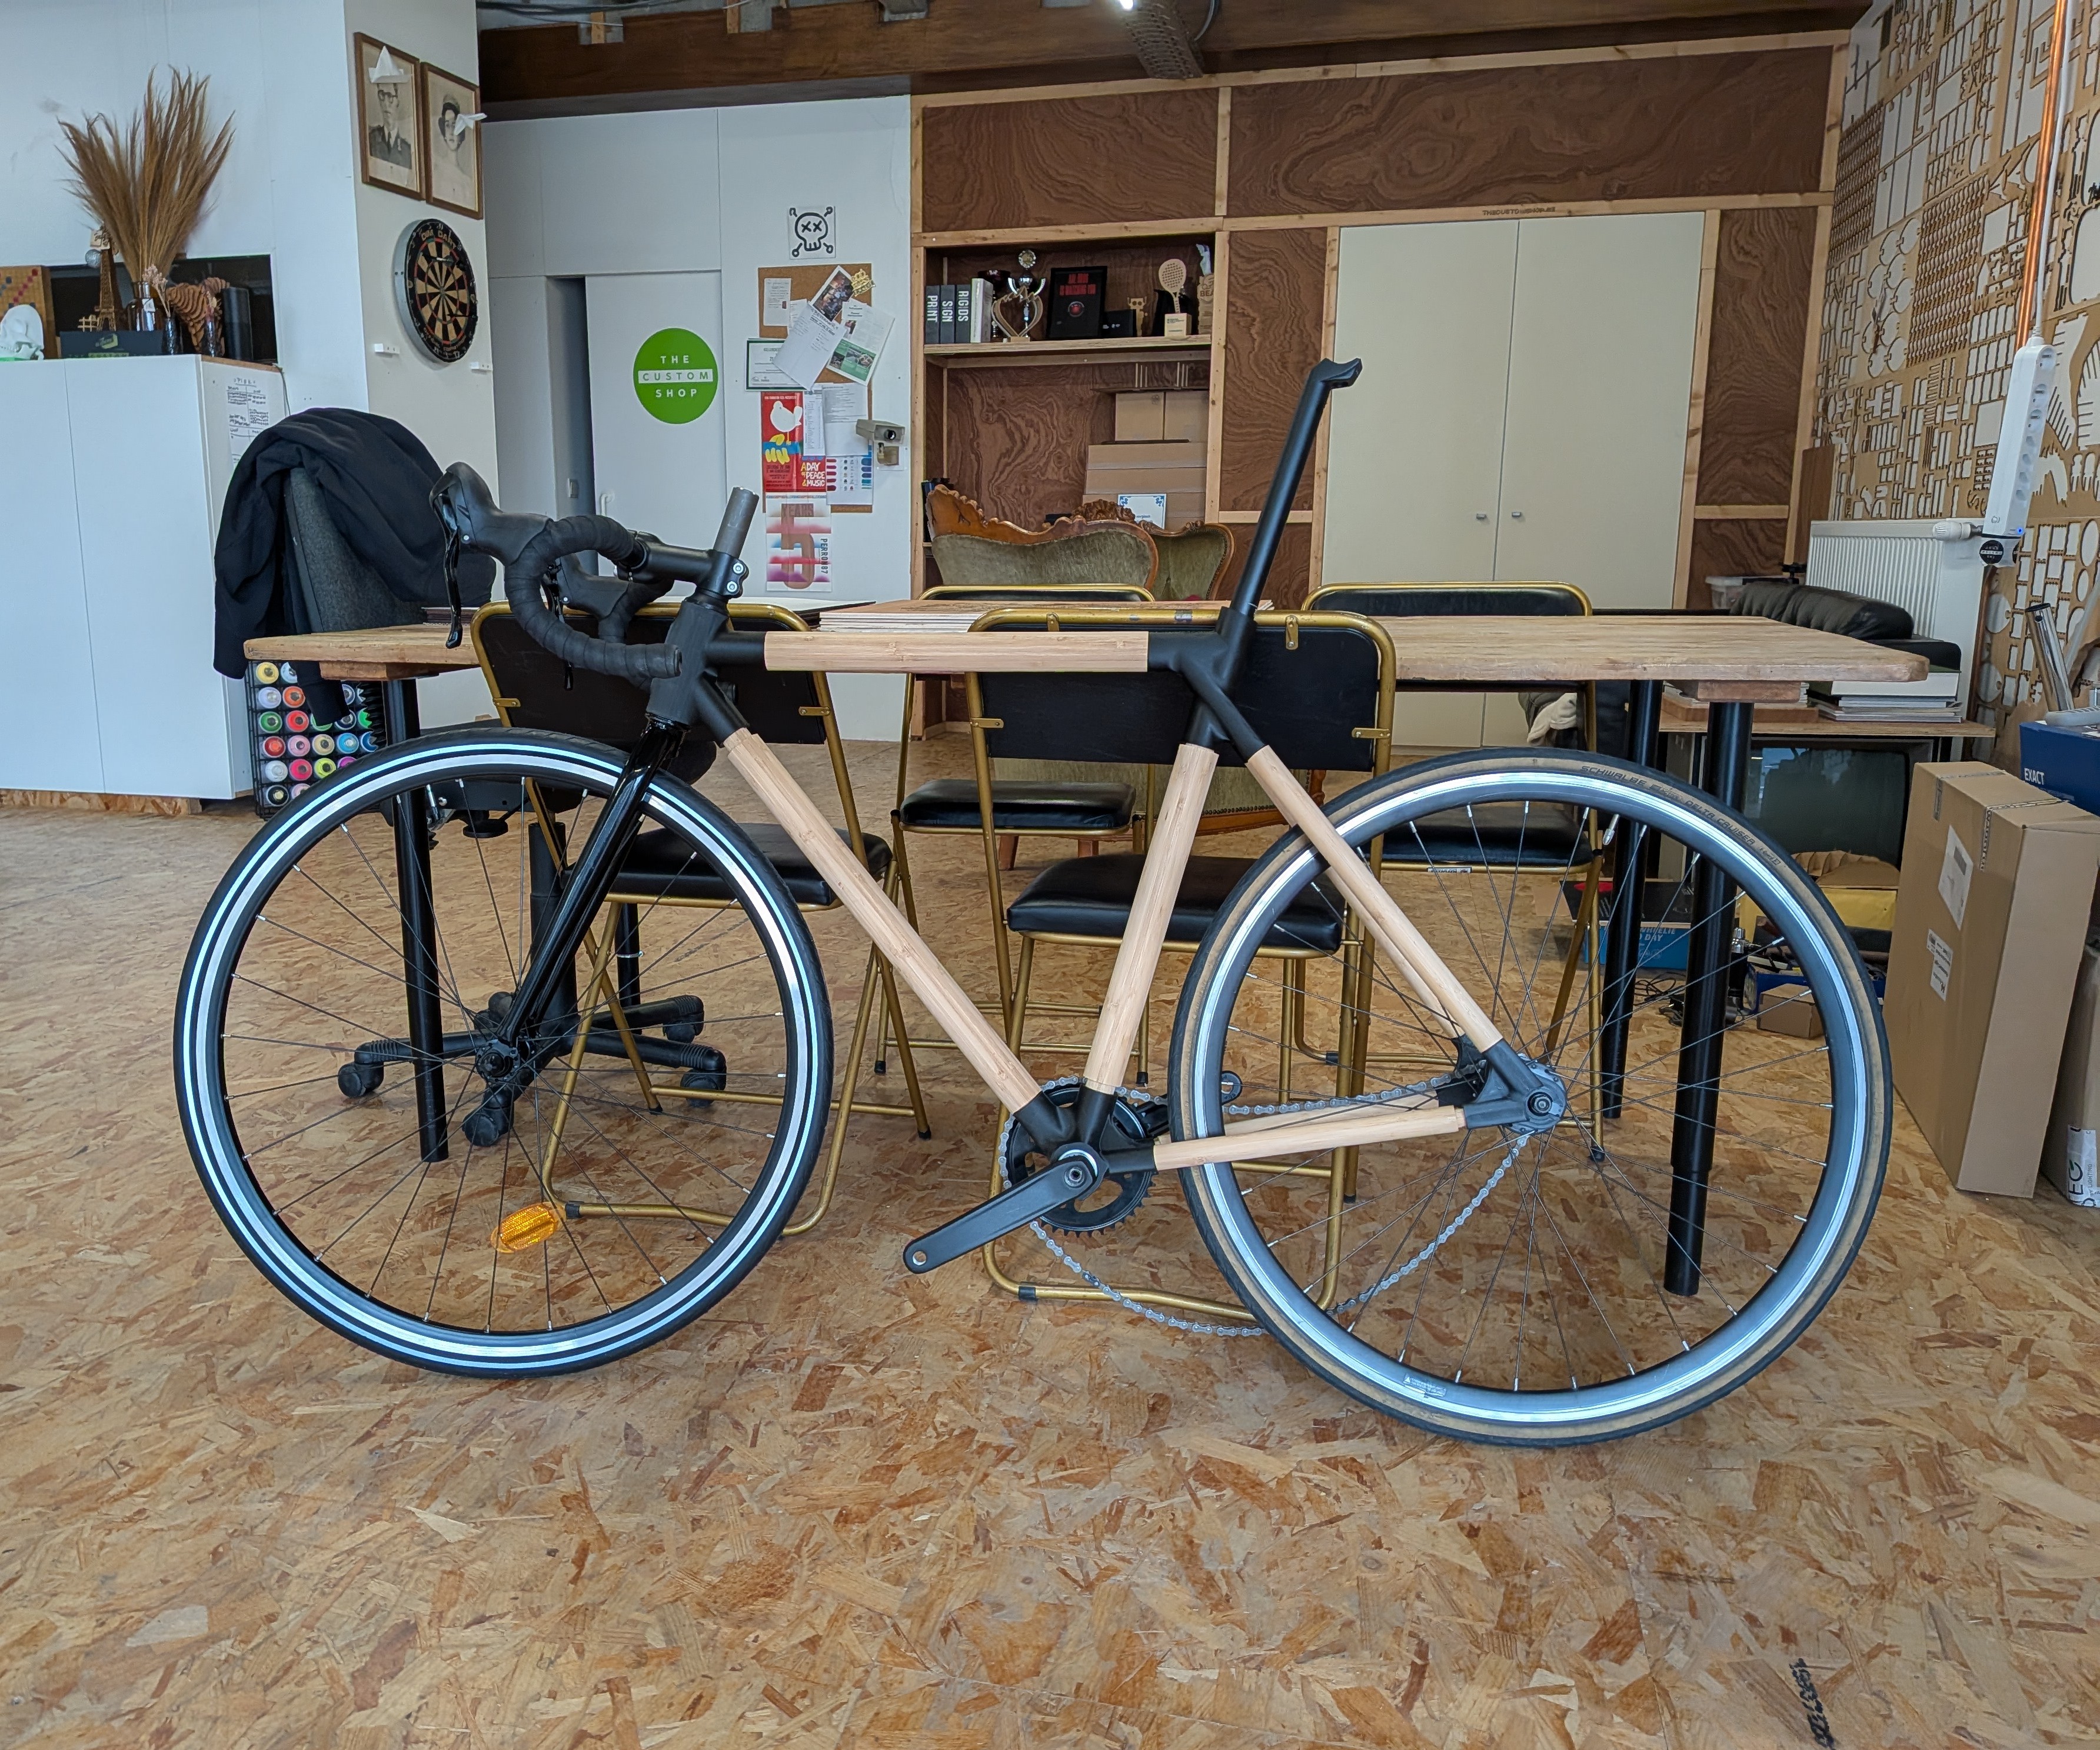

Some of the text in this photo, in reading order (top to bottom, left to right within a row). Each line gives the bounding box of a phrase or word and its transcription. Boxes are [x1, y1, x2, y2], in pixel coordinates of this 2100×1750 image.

[927, 295, 938, 322] PRINT
[941, 301, 953, 322] SIGN
[958, 291, 969, 322] RIGIDS
[660, 355, 690, 364] THE
[642, 372, 710, 382] CUSTOM
[655, 388, 698, 398] SHOP
[806, 462, 821, 471] DAY
[806, 471, 826, 479] PEACE
[2024, 768, 2045, 785] EXACT
[1580, 765, 1756, 845] SCHWALBE DELTA CRUISER
